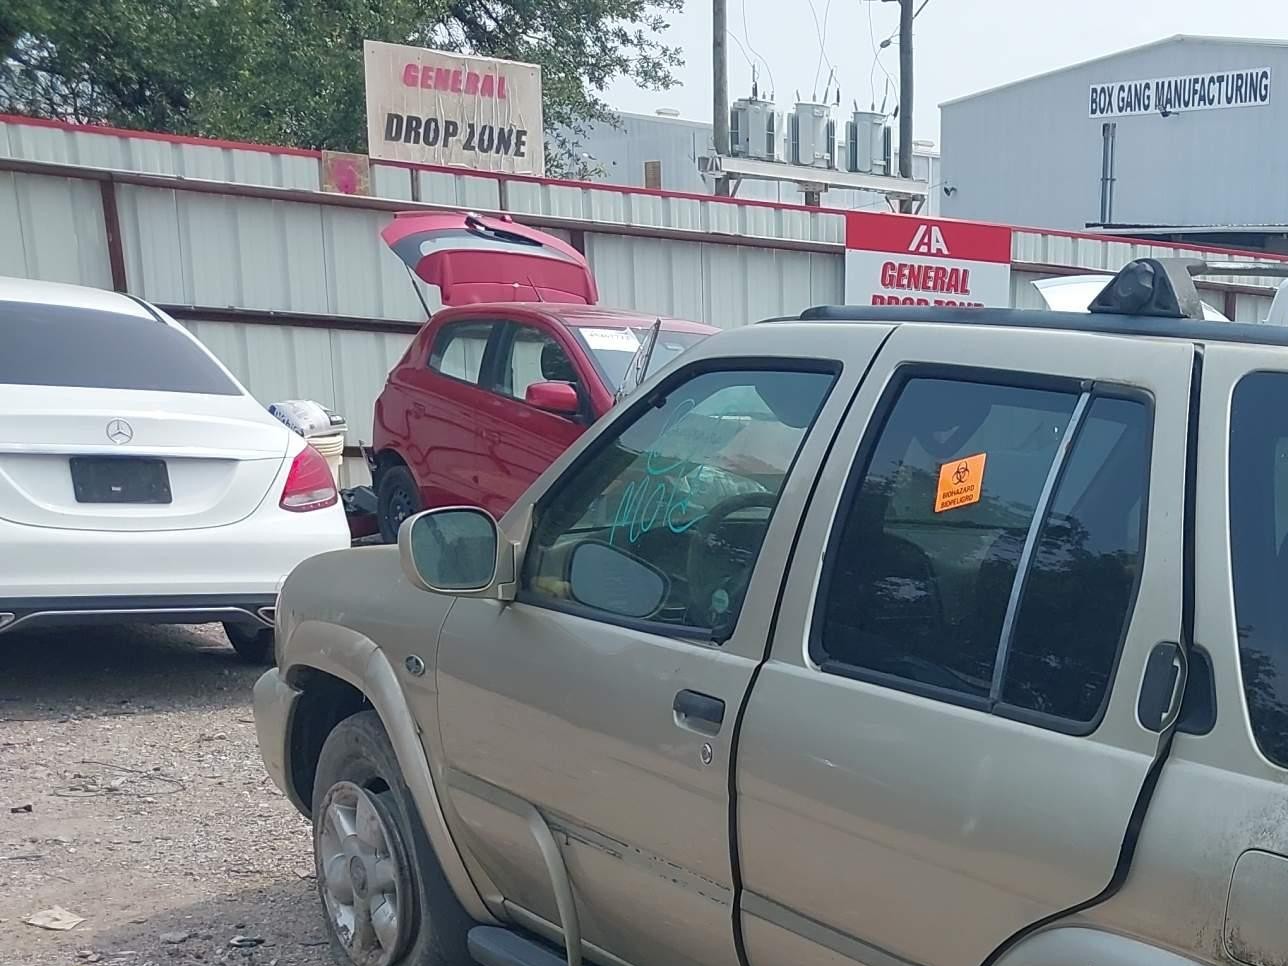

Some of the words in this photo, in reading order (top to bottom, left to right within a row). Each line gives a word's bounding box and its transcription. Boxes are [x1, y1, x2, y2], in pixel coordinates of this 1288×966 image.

[402, 63, 507, 99] GENERAL
[1090, 85, 1114, 115] BOX
[1117, 82, 1151, 113] GANG
[1155, 70, 1269, 111] MANUFACTURING
[384, 112, 459, 148] DROP
[462, 123, 528, 158] ZONE
[880, 261, 970, 296] GENERAL
[942, 484, 975, 500] BIOHAZARD
